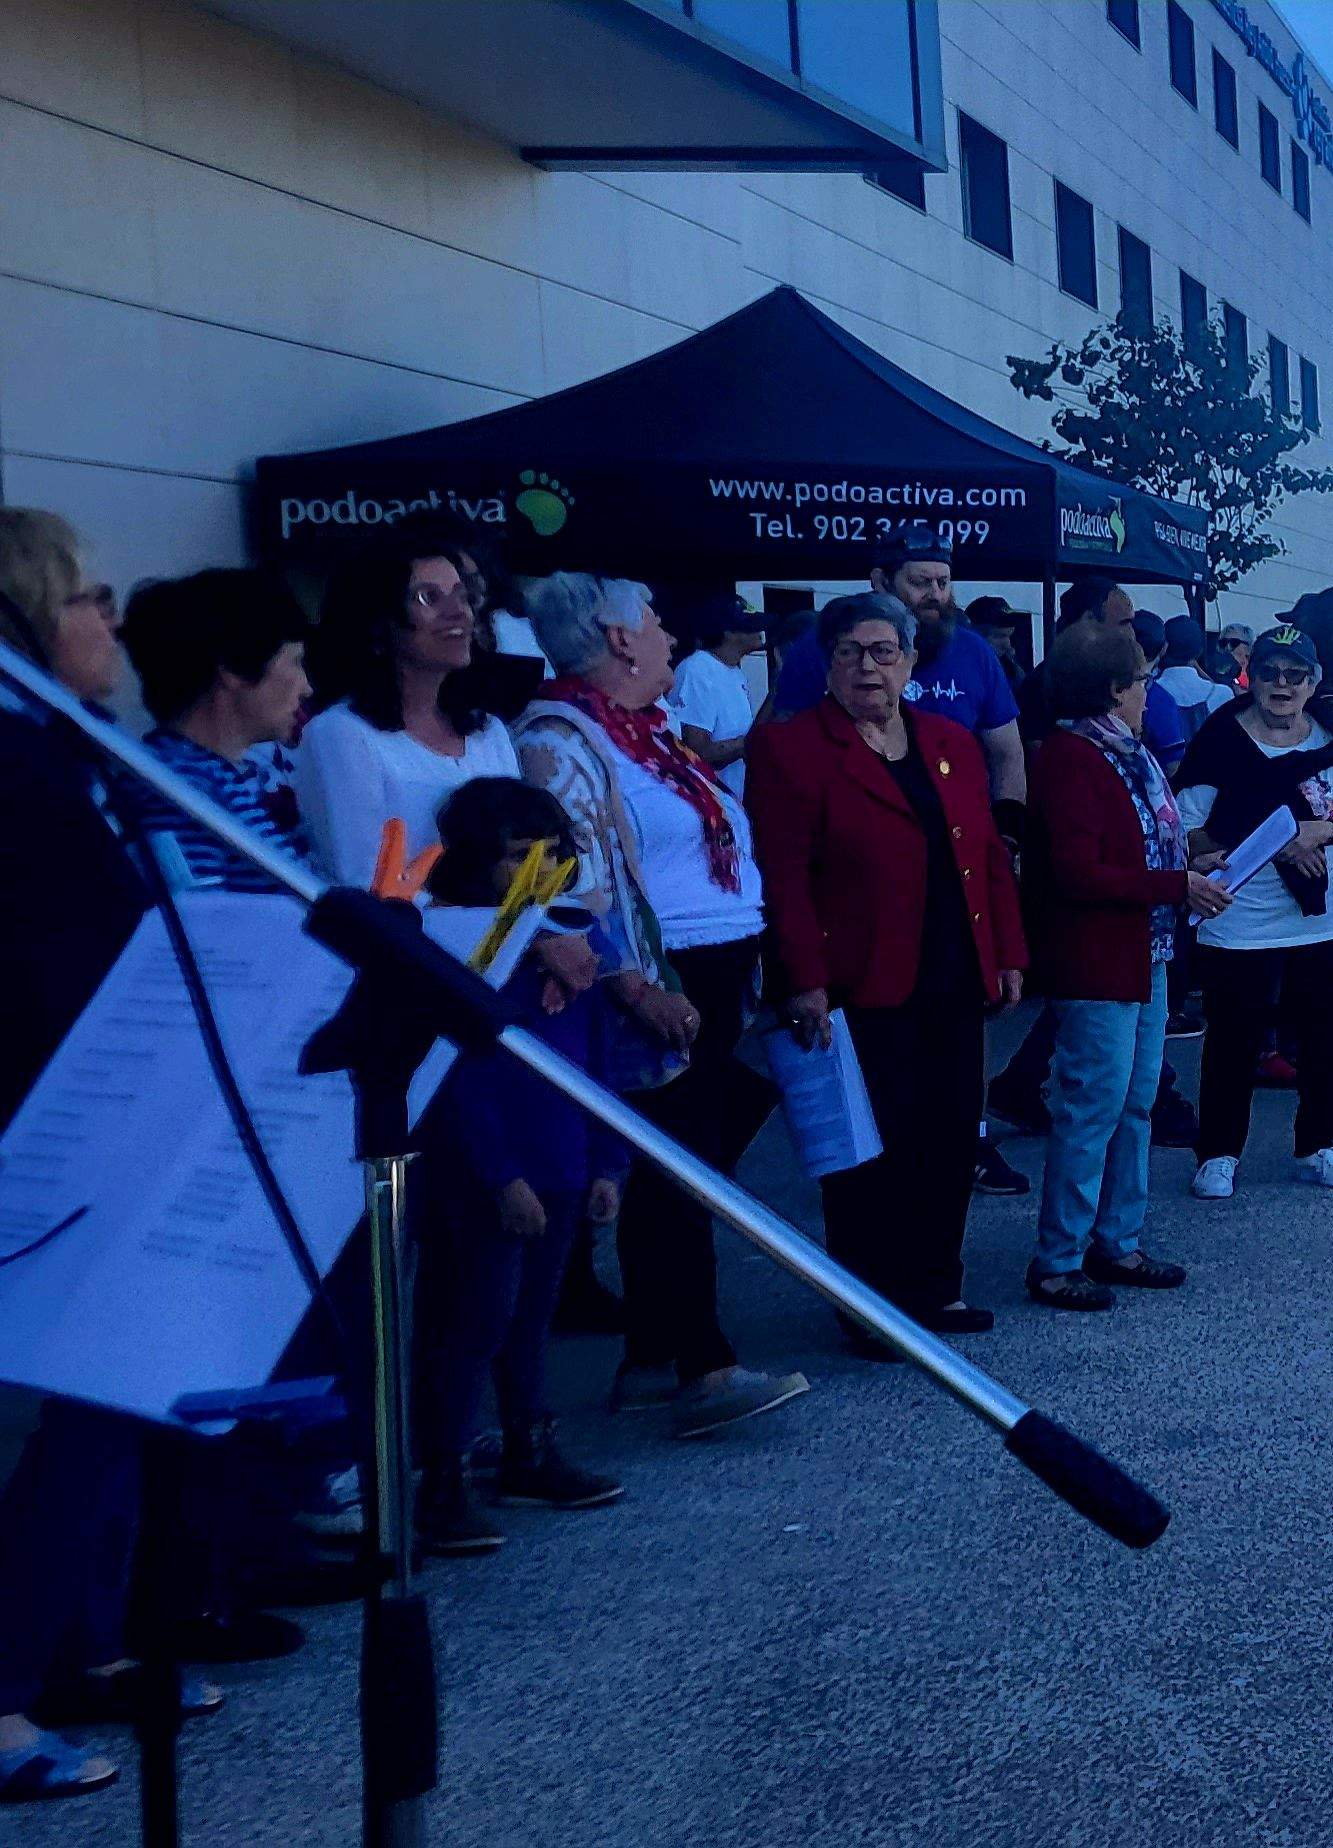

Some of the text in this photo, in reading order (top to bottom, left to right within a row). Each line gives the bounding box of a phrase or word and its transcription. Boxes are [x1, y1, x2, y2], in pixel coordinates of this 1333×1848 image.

[708, 478, 1027, 508] www.podoactiva.com
[749, 512, 804, 540] Tel.
[813, 515, 867, 541] 902
[938, 519, 990, 546] 099
